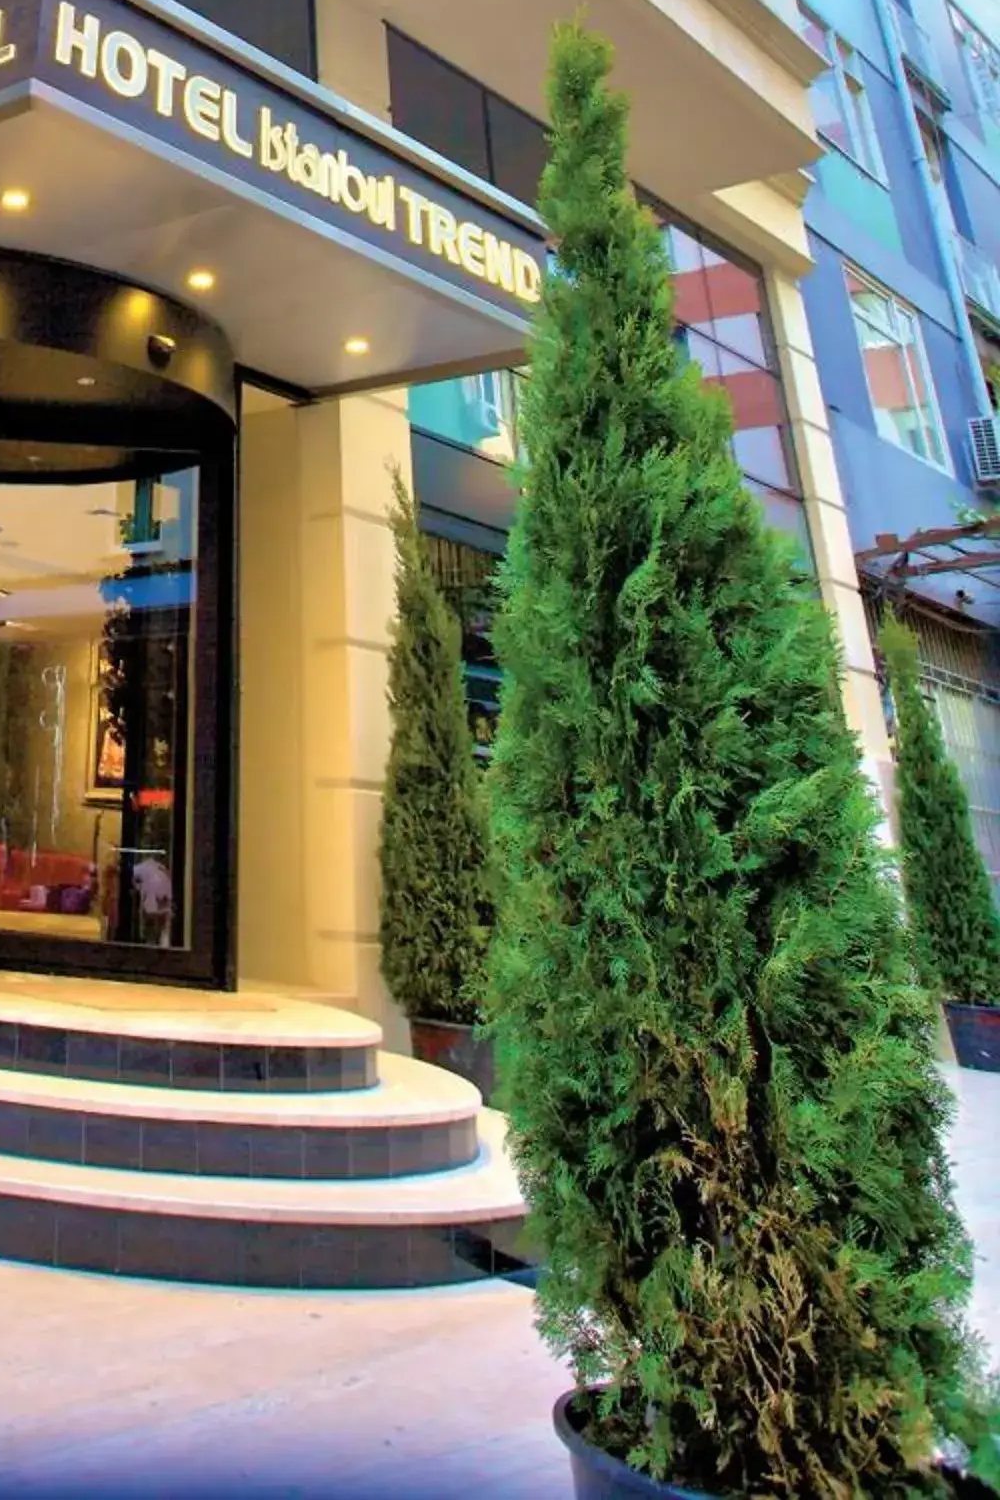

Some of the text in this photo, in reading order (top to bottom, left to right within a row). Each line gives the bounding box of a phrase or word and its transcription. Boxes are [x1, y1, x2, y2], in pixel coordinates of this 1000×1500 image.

[55, 1, 541, 302] HOTEL Istanbul TREND
